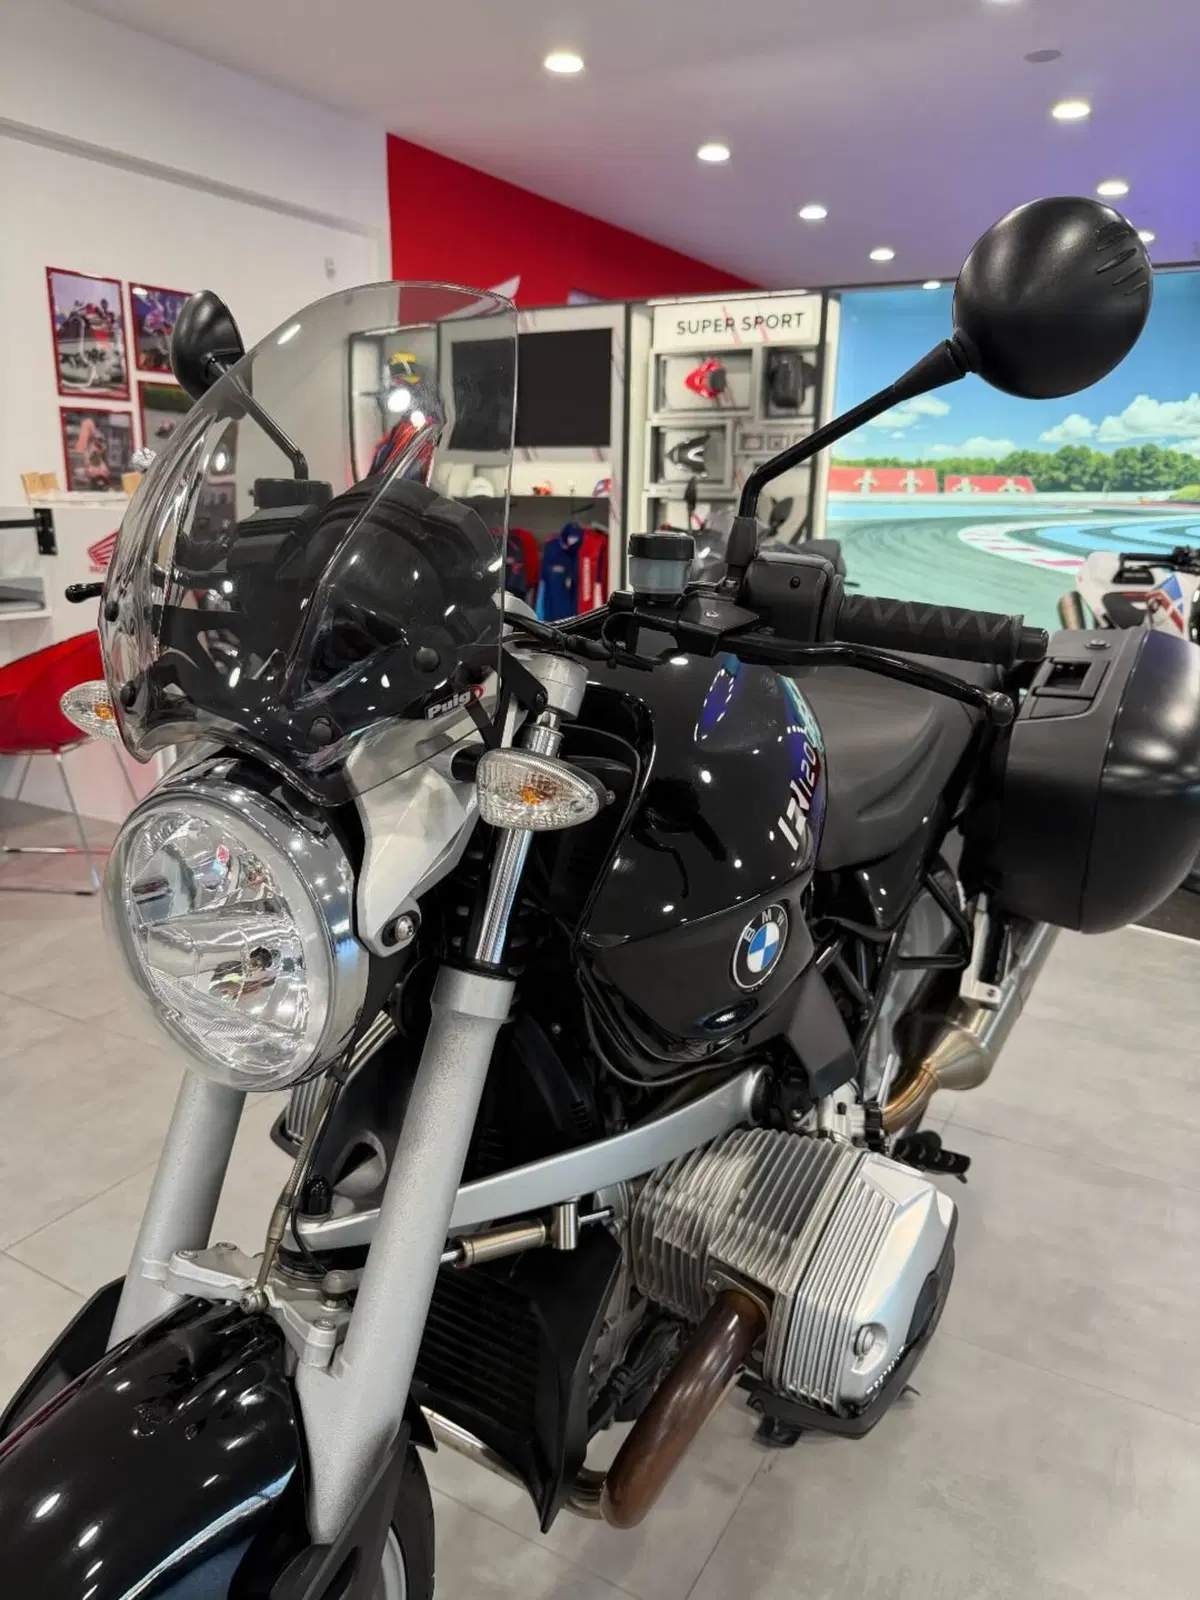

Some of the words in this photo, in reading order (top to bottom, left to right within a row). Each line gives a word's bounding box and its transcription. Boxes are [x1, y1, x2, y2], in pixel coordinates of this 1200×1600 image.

[676, 316, 736, 336] SUPER
[742, 312, 805, 332] SPORT
[427, 690, 472, 720] Puig
[743, 908, 785, 943] BMW
